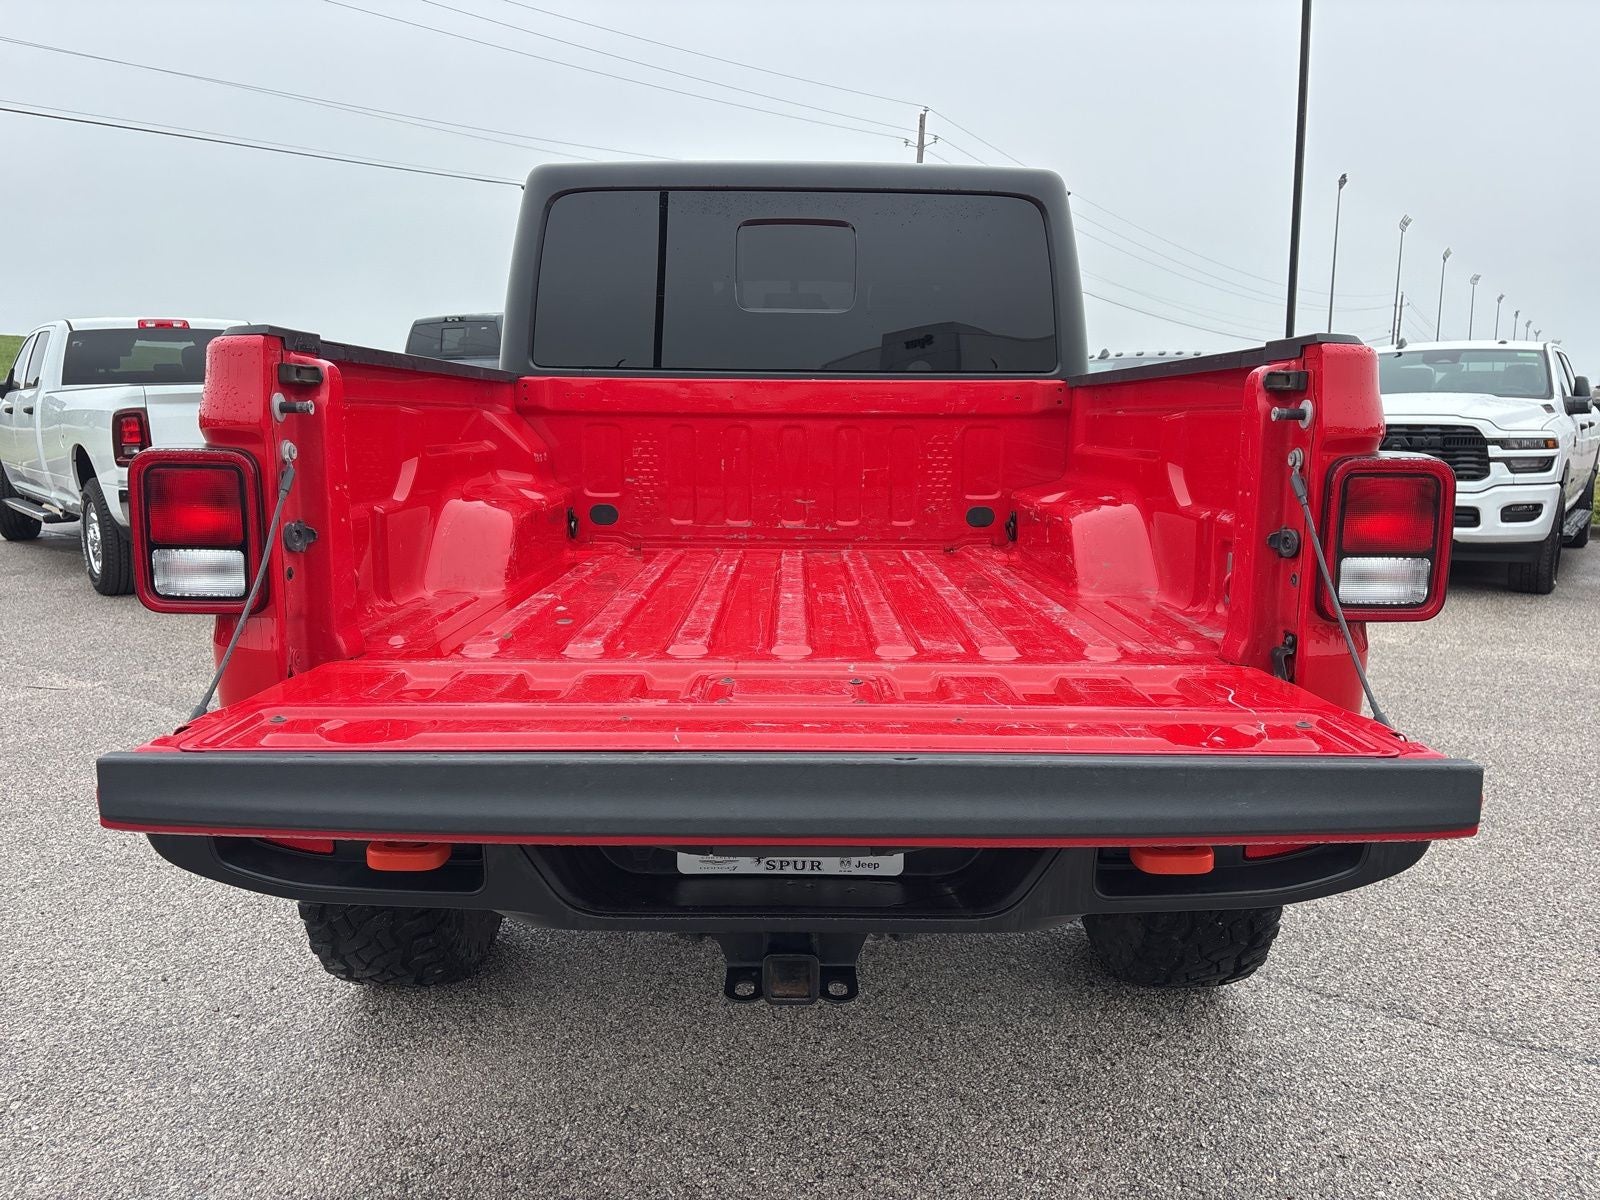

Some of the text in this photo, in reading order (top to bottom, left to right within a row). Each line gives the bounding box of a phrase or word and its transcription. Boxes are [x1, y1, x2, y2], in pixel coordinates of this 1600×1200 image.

[1381, 436, 1441, 448] AM
[765, 859, 823, 871] SPUR
[855, 860, 880, 870] Jeep
